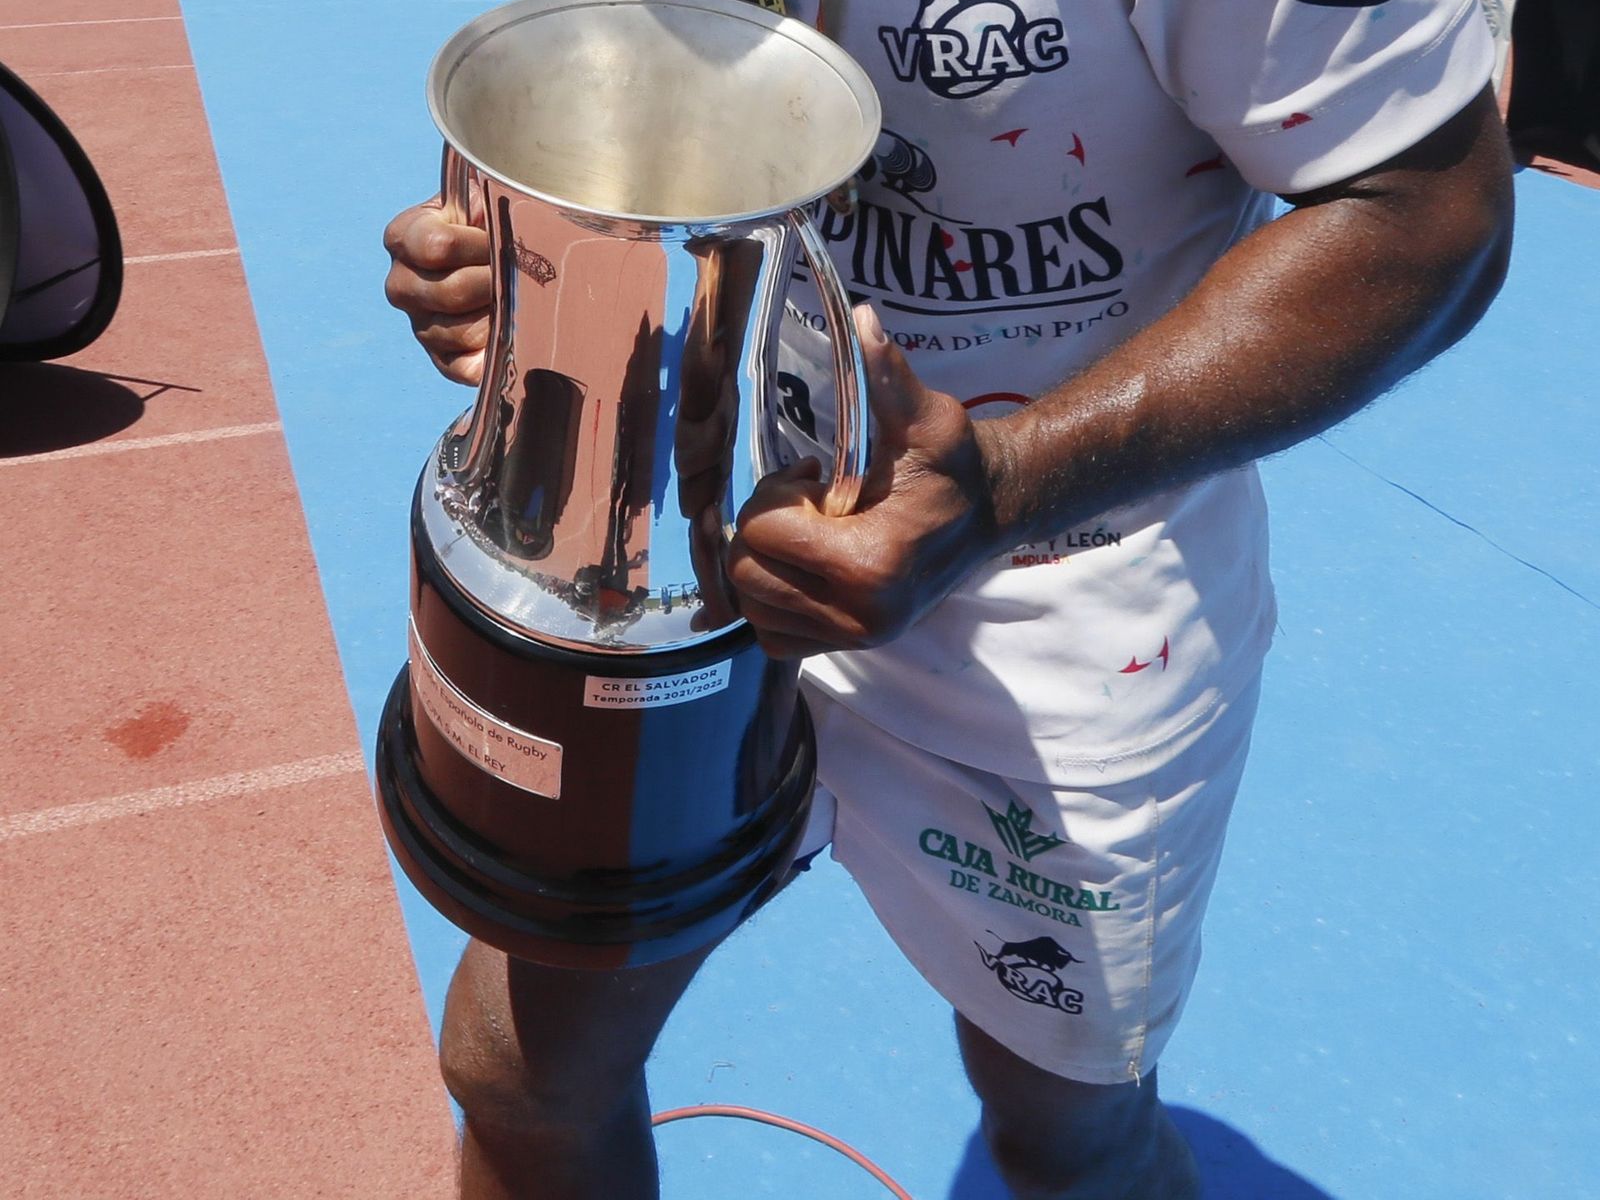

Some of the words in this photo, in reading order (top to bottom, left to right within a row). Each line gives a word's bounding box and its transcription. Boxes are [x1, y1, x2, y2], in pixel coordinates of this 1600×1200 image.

[878, 17, 1070, 83] VRAC
[818, 195, 1124, 301] PINARES
[952, 329, 993, 352] DE
[1001, 320, 1042, 341] UN
[1067, 528, 1122, 549] LEÓN
[593, 694, 660, 705] Temporada
[664, 678, 723, 701] 2021/2022
[602, 683, 620, 692] CR
[625, 684, 641, 692] EL
[646, 669, 718, 692] SALVADOR
[468, 744, 481, 760] EL
[484, 754, 506, 773] REY
[488, 728, 503, 742] de
[507, 736, 548, 761] Rugby
[918, 827, 998, 878] CAJA
[1006, 860, 1121, 912] RURAL
[949, 869, 981, 894] DE
[987, 881, 1082, 928] ZAMORA
[974, 940, 1085, 1015] VRAC
